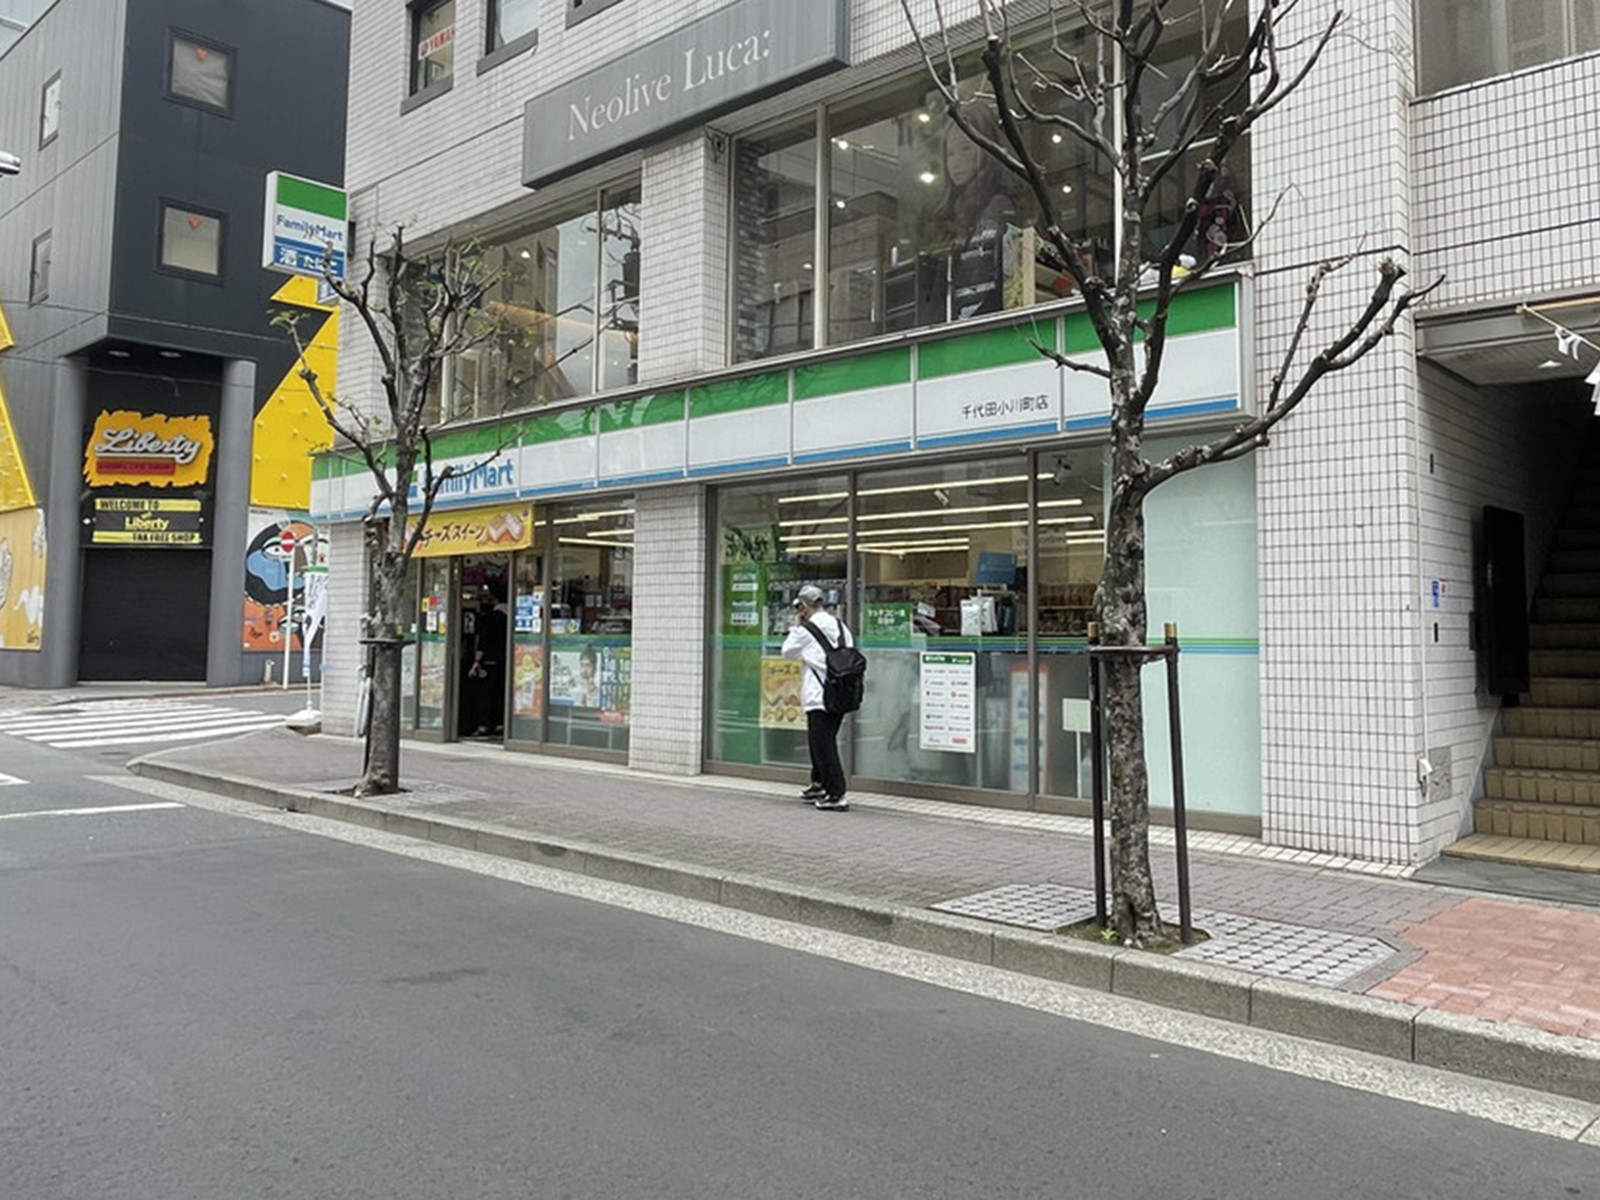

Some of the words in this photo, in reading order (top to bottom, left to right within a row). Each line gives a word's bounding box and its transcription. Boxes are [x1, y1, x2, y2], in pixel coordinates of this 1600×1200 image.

[567, 72, 672, 142] Neolive
[684, 29, 772, 91] Luca:
[276, 214, 344, 241] FamilyMart
[279, 247, 298, 266] 酒
[961, 394, 1049, 419] 千代田小川町店
[94, 429, 201, 464] Liberty
[100, 500, 145, 510] WELCOME
[148, 500, 160, 510] TO
[124, 516, 170, 531] Liberty
